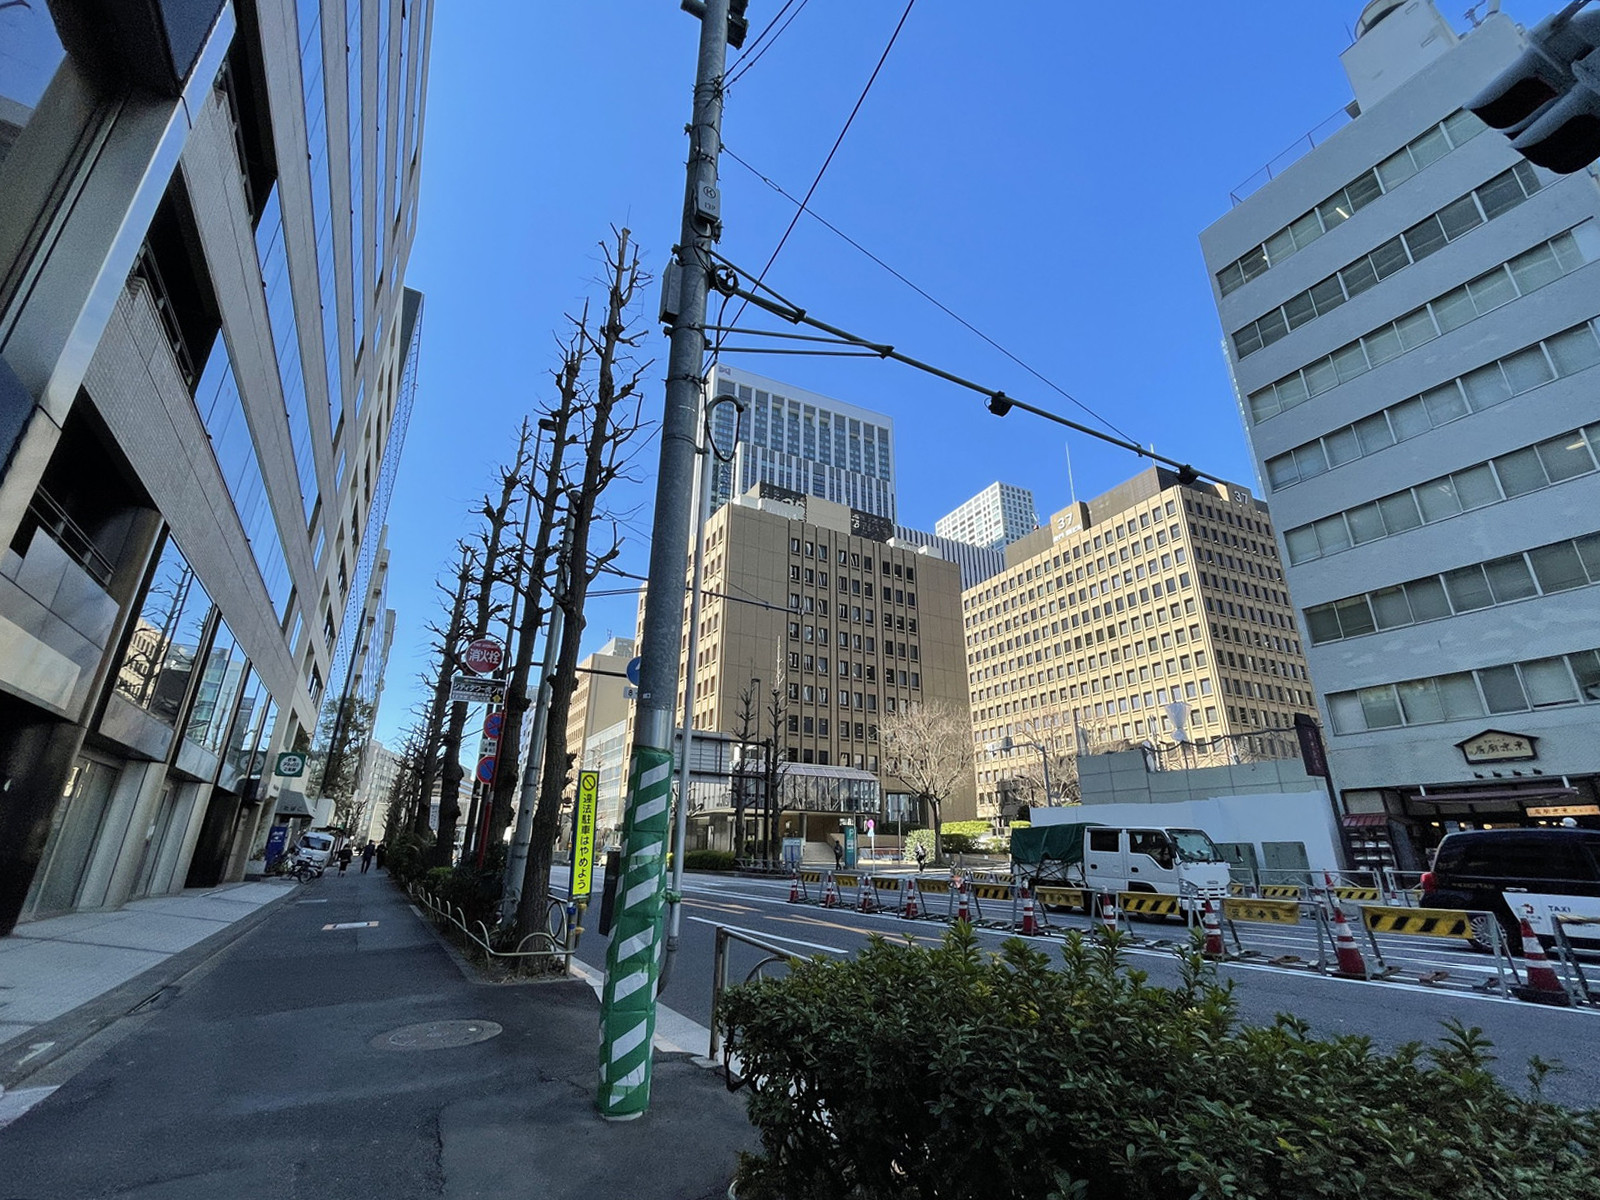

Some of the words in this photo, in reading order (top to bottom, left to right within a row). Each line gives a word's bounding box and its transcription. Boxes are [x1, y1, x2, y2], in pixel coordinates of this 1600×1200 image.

[1234, 491, 1247, 504] 37
[1057, 512, 1073, 530] 37
[469, 649, 500, 664] 消火栓
[577, 793, 592, 889] 違法駐車はやめよう
[1548, 905, 1571, 913] TAXI
